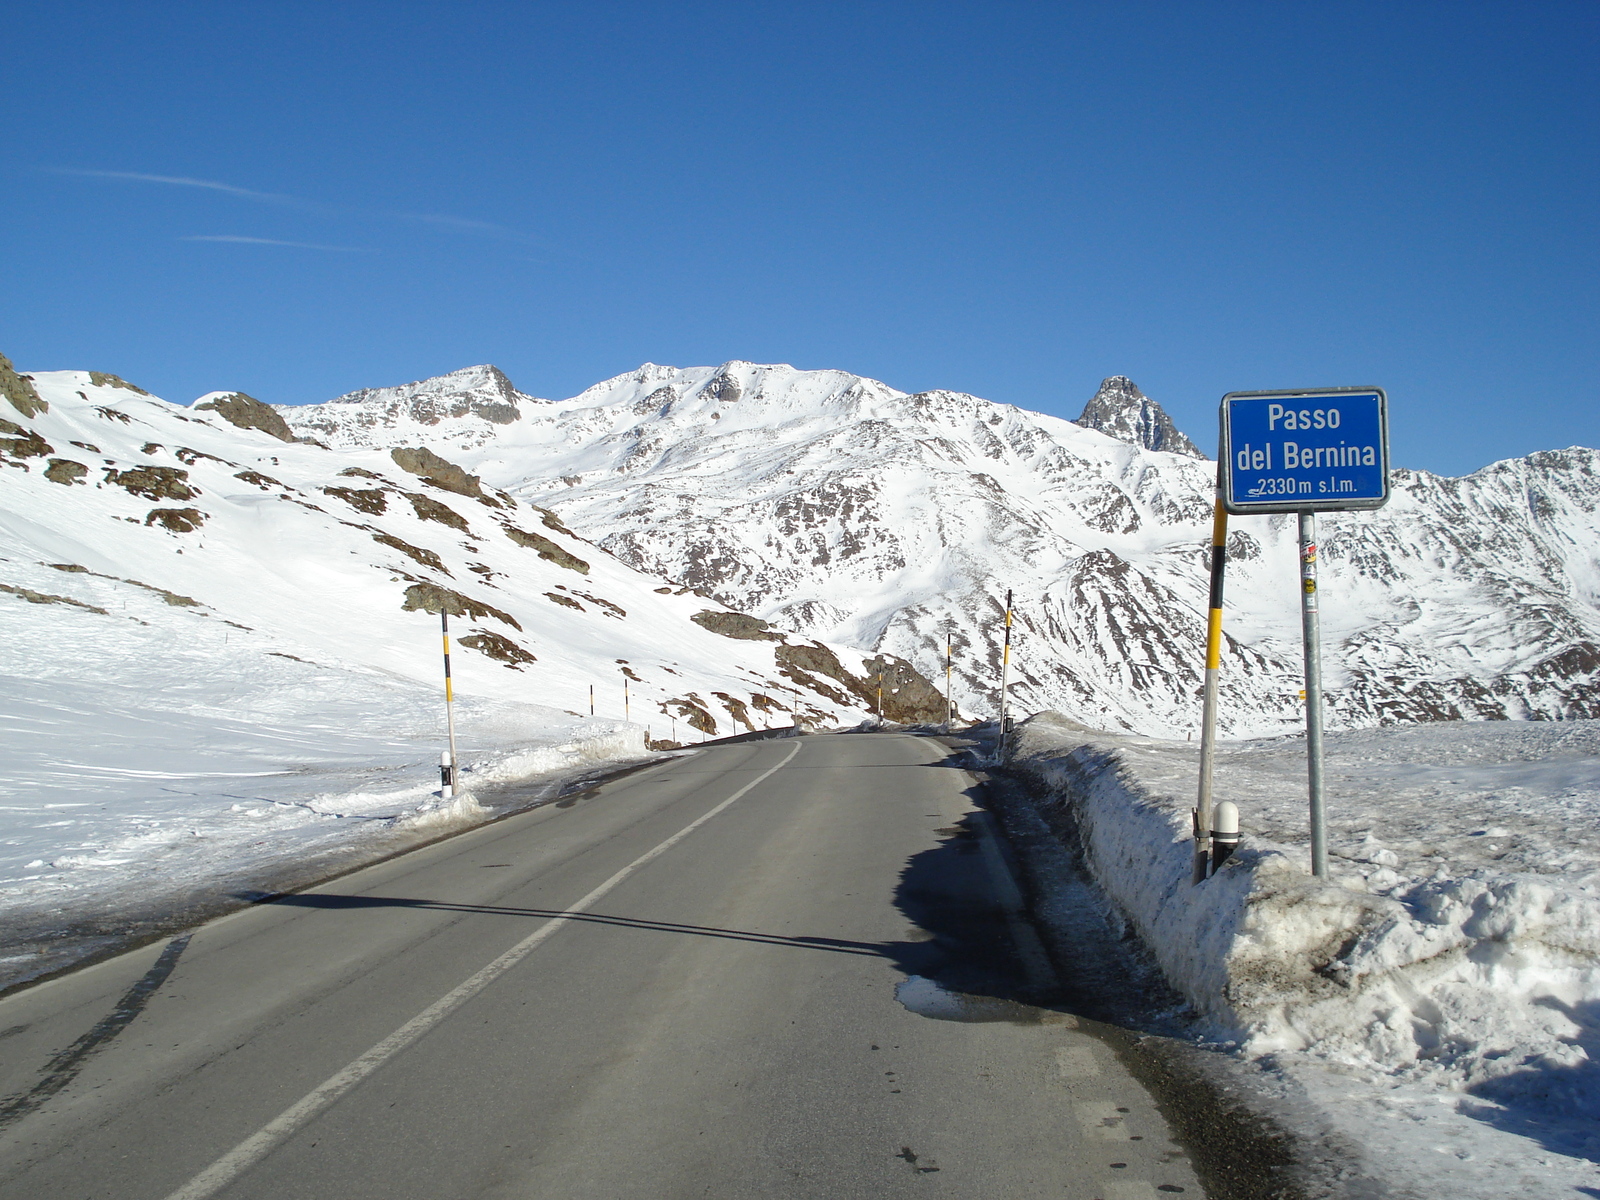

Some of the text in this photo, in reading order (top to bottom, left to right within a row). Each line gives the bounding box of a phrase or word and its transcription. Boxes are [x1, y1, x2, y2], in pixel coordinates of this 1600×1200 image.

[1268, 404, 1340, 431] Passo
[1237, 441, 1376, 471] del Bernina
[1318, 476, 1358, 493] s.l.m.
